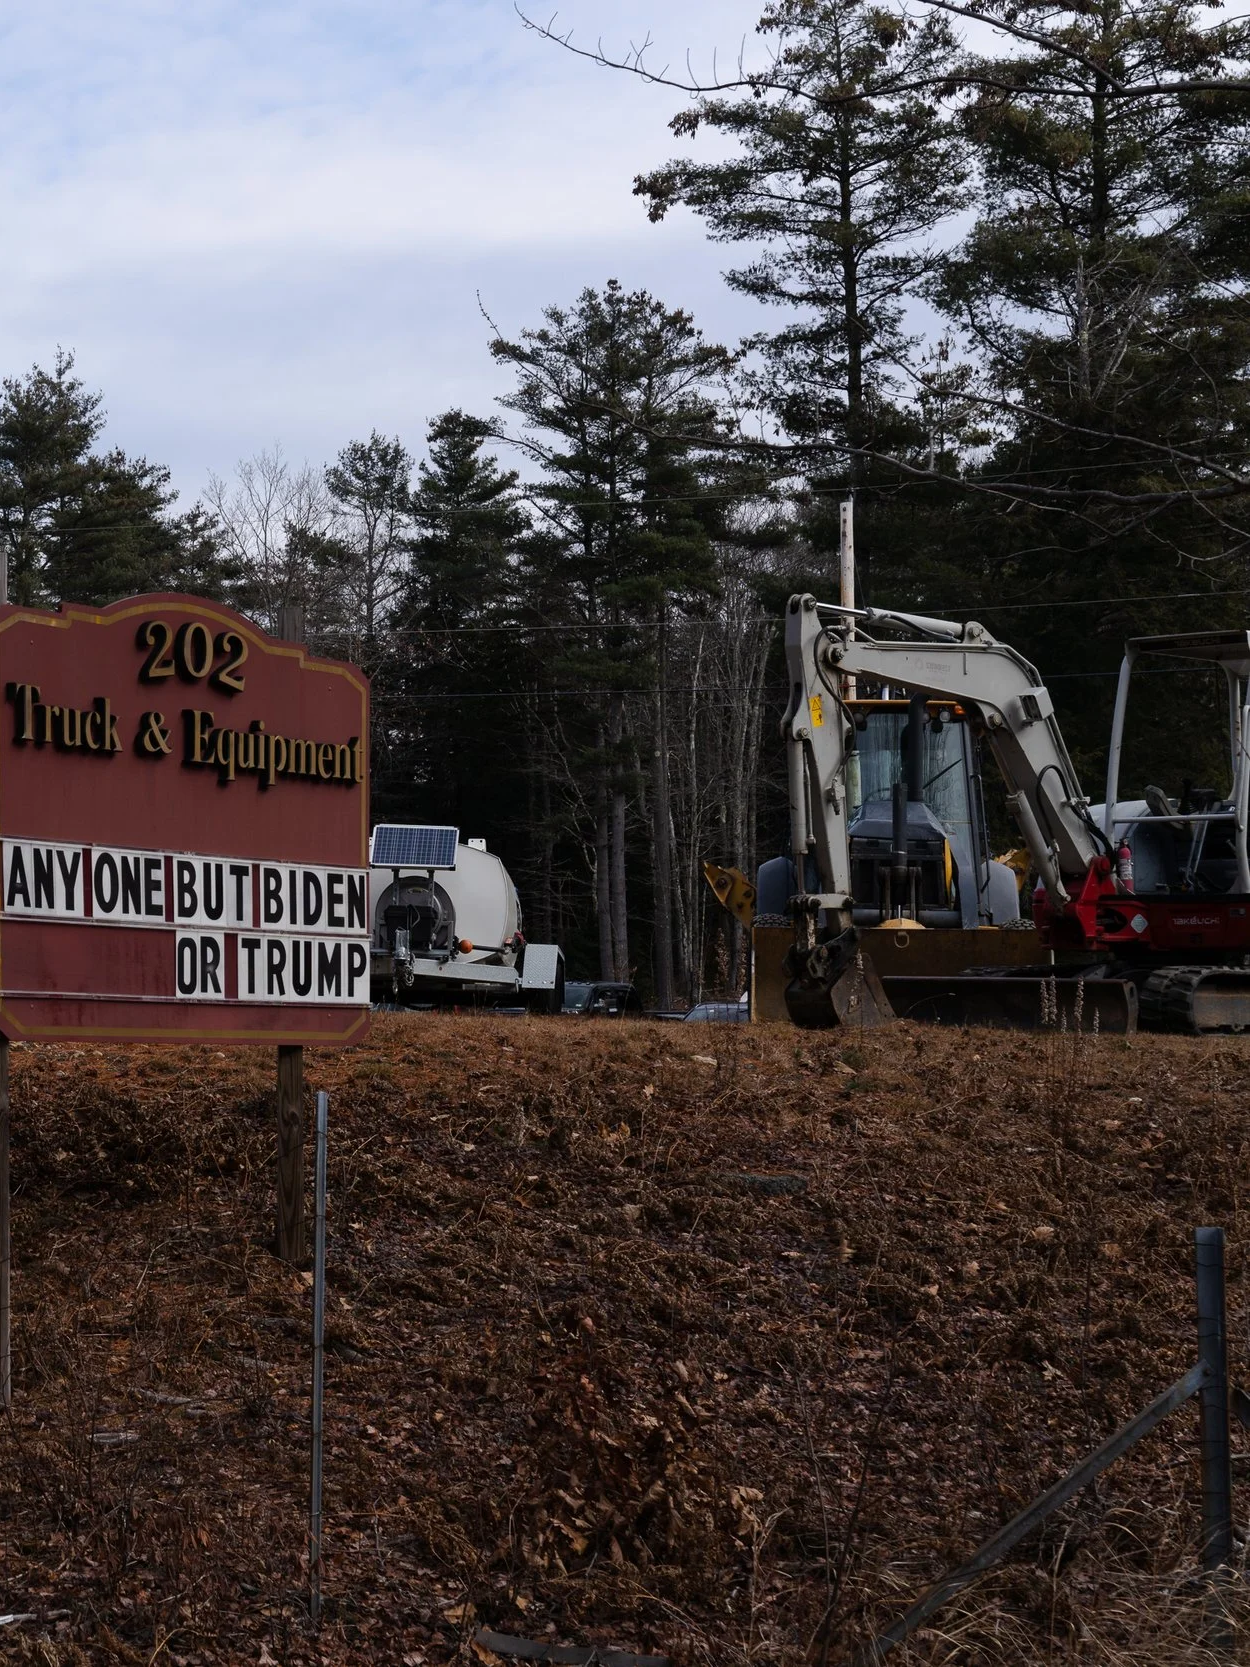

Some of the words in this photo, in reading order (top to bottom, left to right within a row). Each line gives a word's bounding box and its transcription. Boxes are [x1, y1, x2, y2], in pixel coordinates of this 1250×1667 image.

[138, 620, 249, 695] 202
[7, 682, 124, 752] Truck
[136, 710, 173, 757] &
[183, 710, 365, 786] Equipment
[176, 859, 250, 923] BUT
[262, 866, 366, 930] BIDEN
[1171, 915, 1221, 925] TAKEUCHI
[176, 935, 222, 997] OR
[241, 937, 368, 998] TRUMP
